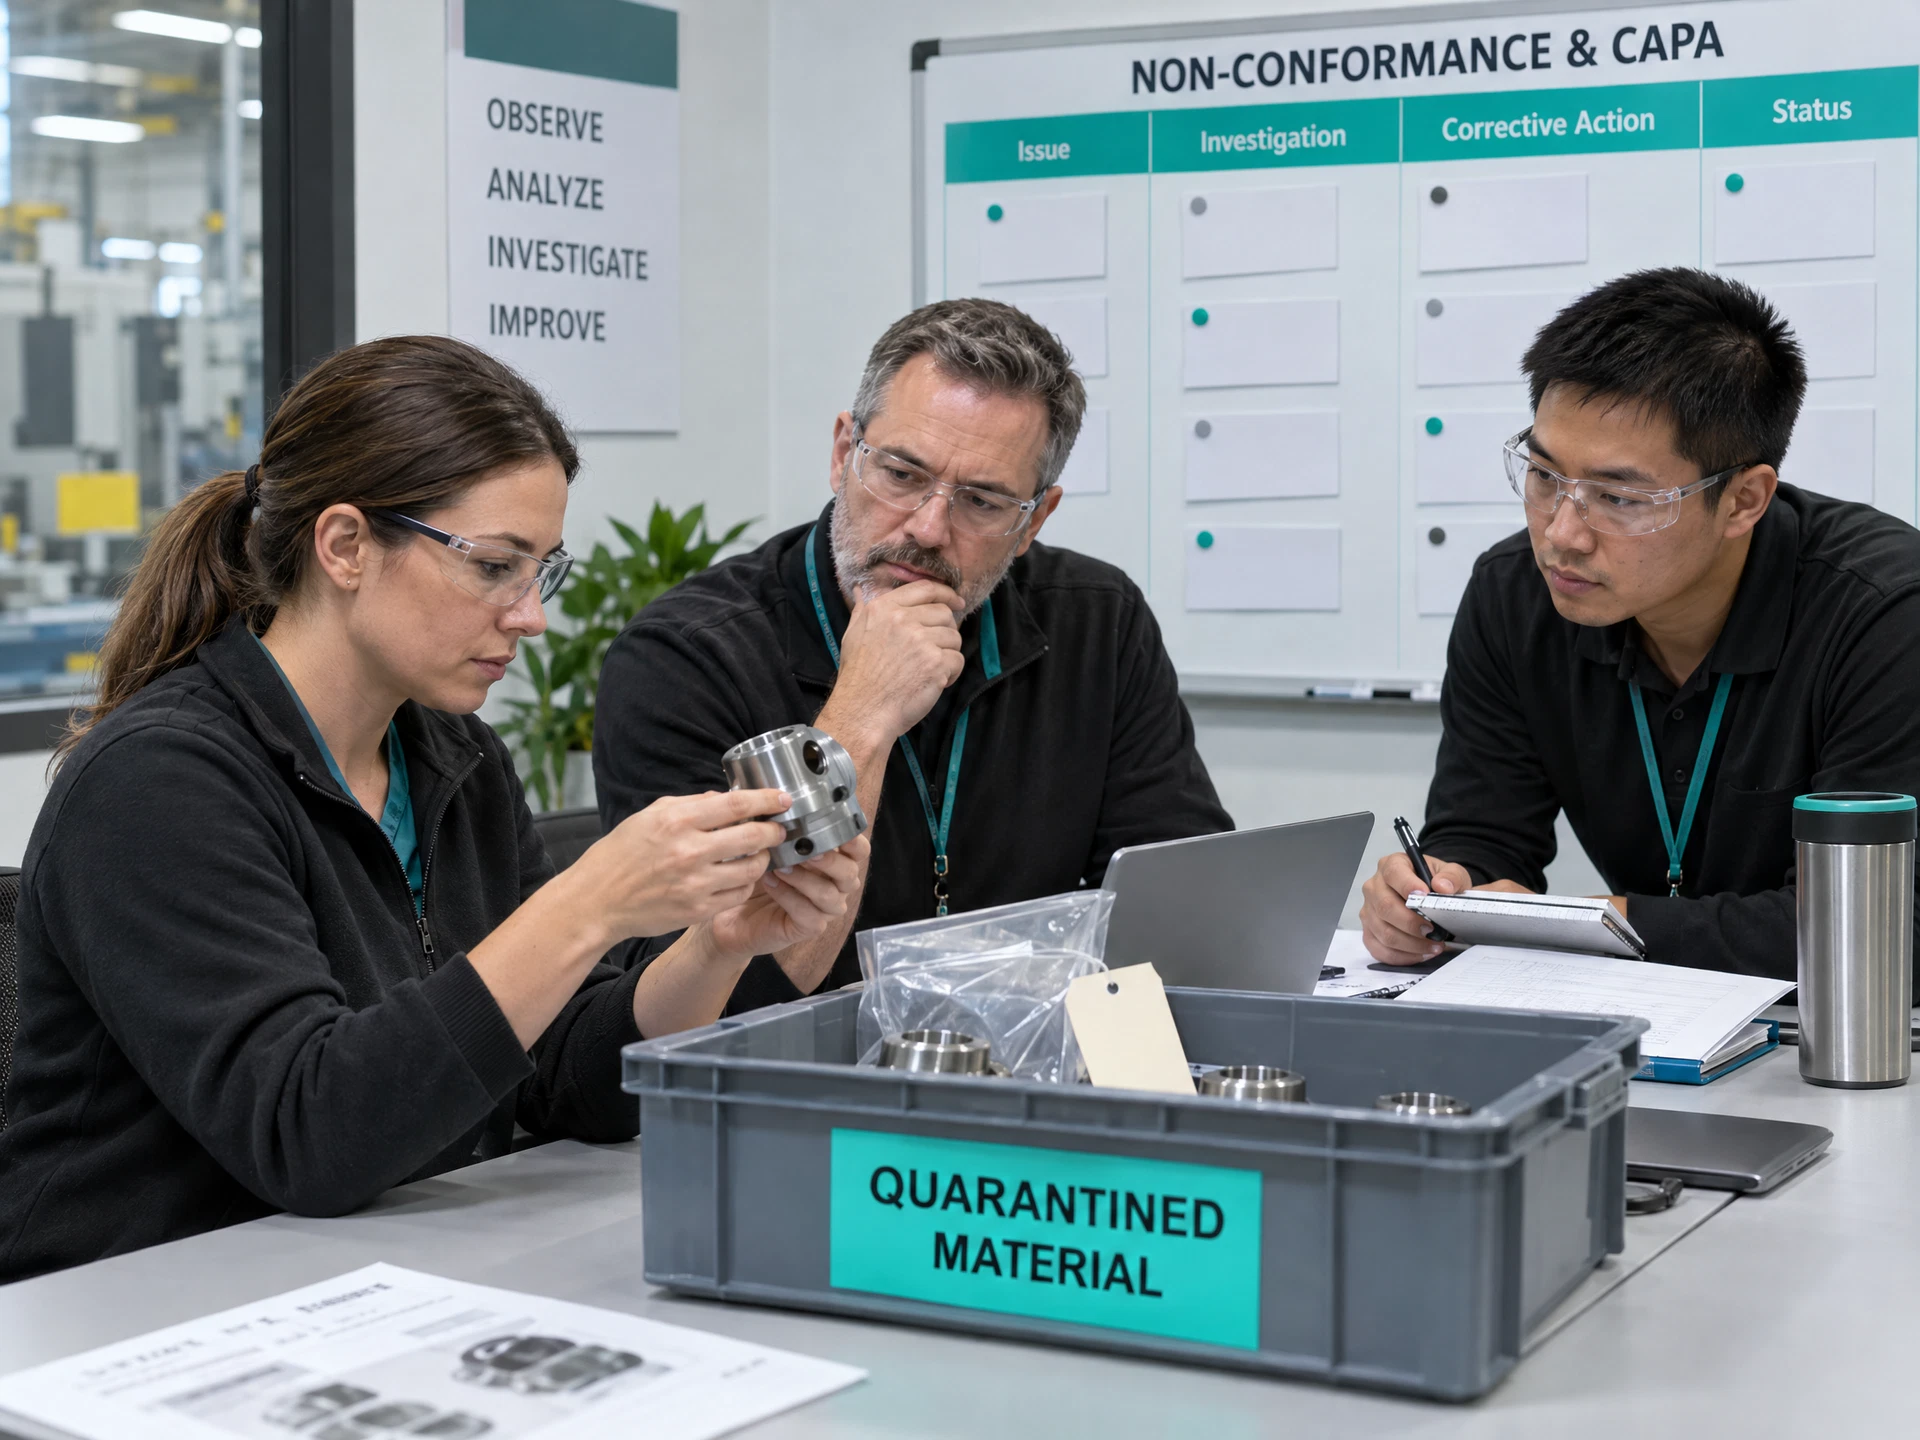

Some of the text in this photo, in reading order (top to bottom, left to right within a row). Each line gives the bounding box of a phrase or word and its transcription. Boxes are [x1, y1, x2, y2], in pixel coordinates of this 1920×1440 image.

[1132, 20, 1725, 95] NON-CONFORMANCE & CAPA
[487, 98, 604, 143] OBSERVE
[1442, 107, 1655, 142] Corrective Action
[1772, 97, 1852, 125] Status
[1018, 140, 1071, 162] Issue
[1201, 124, 1346, 156] Investigation
[487, 167, 604, 210] ANALYZE
[488, 235, 649, 281] INVESTIGATE
[489, 303, 606, 342] IMPROVE
[869, 1165, 1226, 1239] QUARANTINED
[933, 1231, 1163, 1299] MATERIAL
